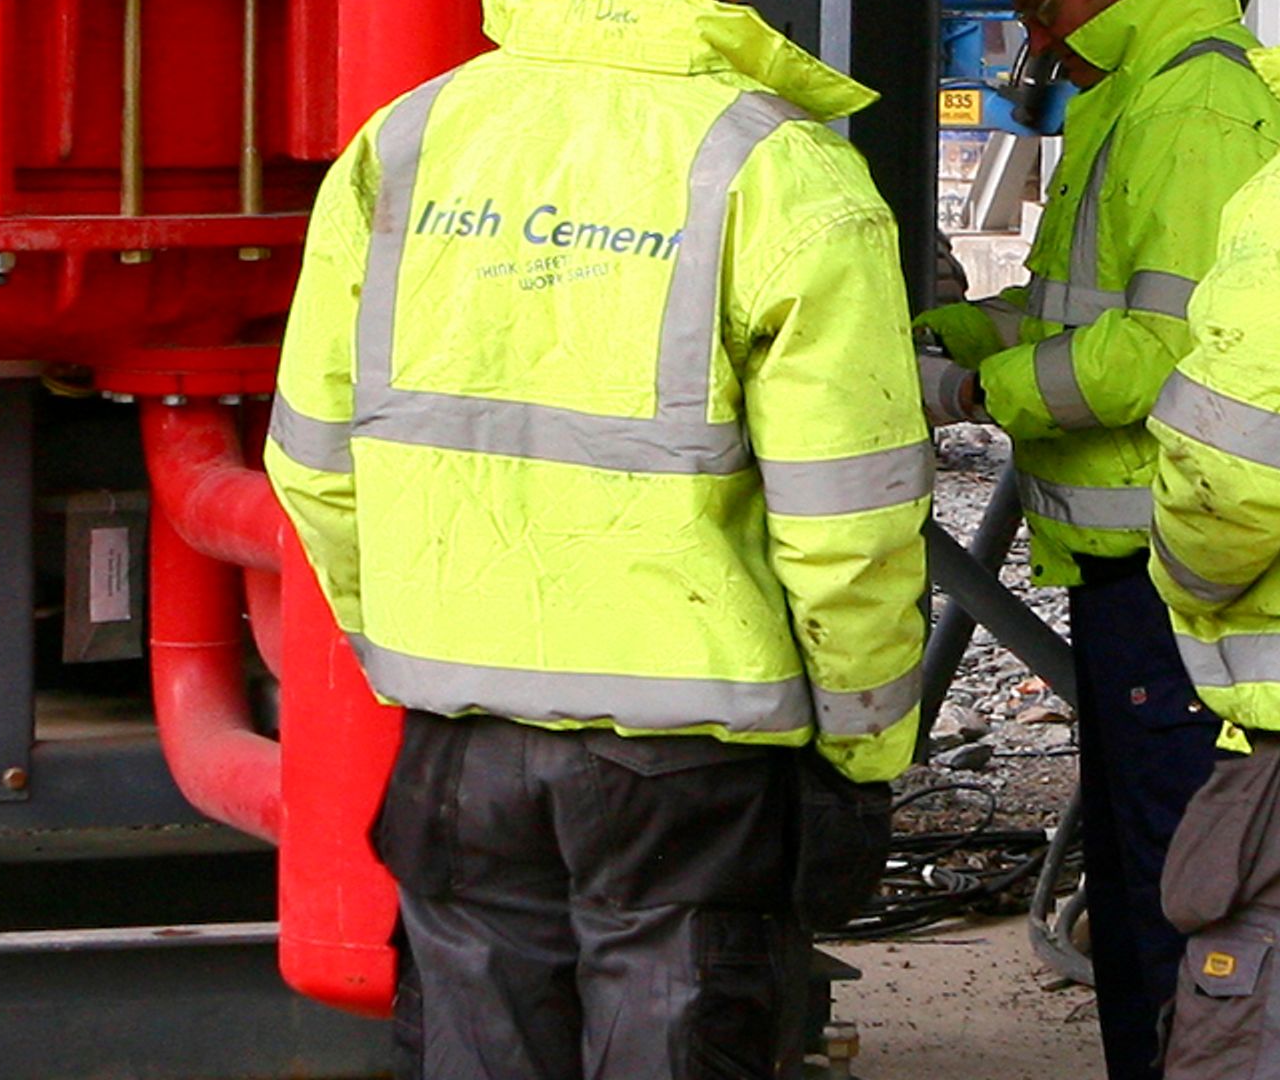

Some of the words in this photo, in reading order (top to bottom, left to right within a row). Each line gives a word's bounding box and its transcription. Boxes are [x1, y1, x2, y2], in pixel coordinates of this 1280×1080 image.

[944, 93, 973, 109] 835
[415, 198, 502, 238] Irish
[523, 204, 684, 261] Cement
